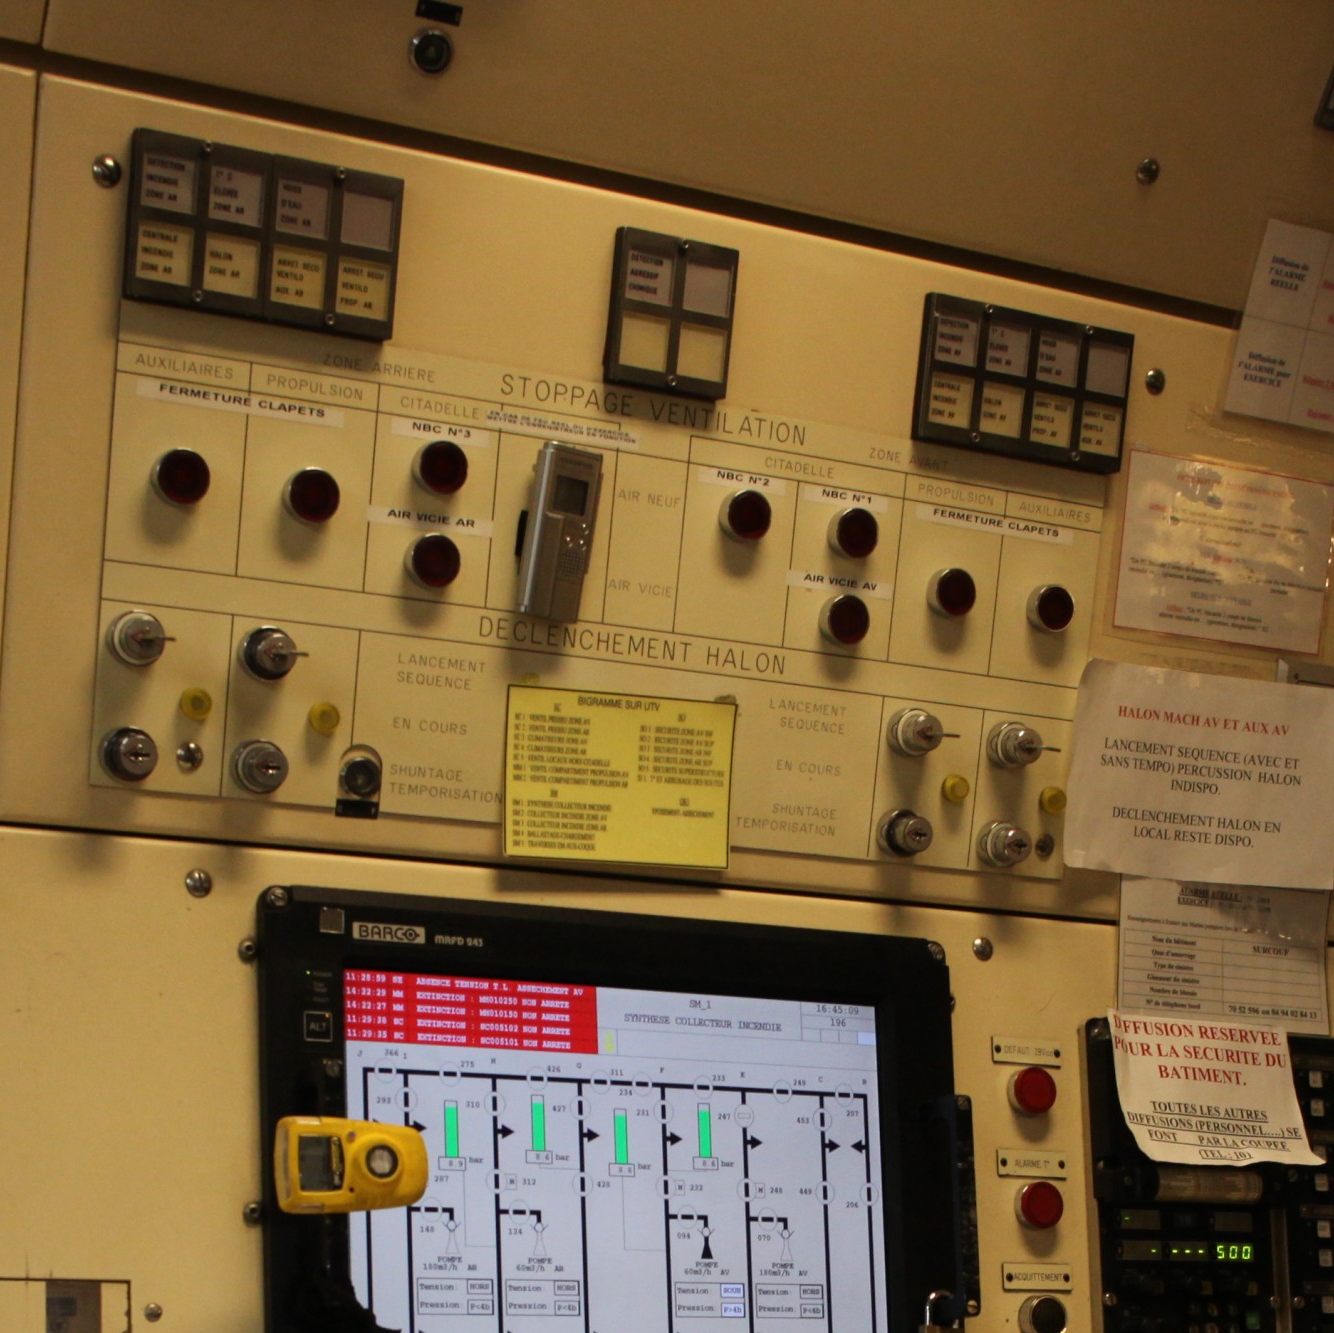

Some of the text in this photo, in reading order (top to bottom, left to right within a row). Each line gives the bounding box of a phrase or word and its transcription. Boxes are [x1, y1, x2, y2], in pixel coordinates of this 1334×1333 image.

[135, 352, 234, 380] AUXILIAIRES
[322, 353, 436, 384] ZONE ARRIERE
[266, 373, 364, 401] PROPULSION
[159, 383, 326, 418] FERMETURE CLAPETS
[399, 396, 480, 420] CITADELLE
[500, 373, 807, 447] STOPPAGE VENTILATION
[411, 421, 471, 440] NBC N°3
[764, 456, 835, 480] CITADELLE
[868, 447, 949, 471] ZONE AVANT
[716, 470, 770, 487] NBC N°2
[617, 488, 681, 509] AIR NEUF
[821, 488, 873, 504] NBC N°1
[917, 482, 995, 507] PROPULSION
[387, 508, 476, 529] AIR VICIE AR
[933, 507, 1060, 538] FERMETURE CLAPETS
[1018, 501, 1091, 524] AUXILIAIRES
[608, 577, 673, 599] AIR VICIE
[803, 572, 878, 592] AIR VICIE AV
[478, 615, 787, 676] DECLENCHEMENT HALON
[397, 651, 486, 674] LANCEMENT
[396, 670, 473, 692] SEQUENCE
[577, 695, 661, 712] BIGRAMME SUR UTV
[769, 698, 847, 718] LANCEMENT
[392, 717, 468, 736] EN COURS
[779, 716, 846, 735] SEQUENCE
[1117, 705, 1291, 737] HALON MACH AV ET AUX AV
[1104, 736, 1301, 771] LANCEMENT SEQUENCE (AVEC ET
[389, 763, 464, 783] SHUNTAGE
[775, 760, 842, 777] EN COURS
[1100, 754, 1302, 787] SANS TEMPO) PERCUSSION HALON
[389, 783, 503, 804] TEMPORISATION
[1170, 778, 1221, 798] INDISPO.
[771, 802, 838, 821] SHUNTAGE
[1111, 806, 1282, 834] DECLENCHEMENT HALON EN
[735, 816, 836, 838] TEMPORISATION
[1133, 825, 1255, 850] LOCAL RESTE DISPO.
[357, 923, 421, 943] BARCO
[1252, 945, 1290, 957] SURCOUF
[416, 991, 466, 1003] EXTINCTION
[416, 1005, 466, 1017] EXTINCTION
[816, 1003, 860, 1016] 16:45:09
[308, 1021, 328, 1033] ALT
[417, 1018, 466, 1030] EXTINCTION
[624, 1012, 783, 1033] SYNTHESE COLLECTEUR INCENDIE
[829, 1017, 847, 1028] 196
[1113, 1014, 1282, 1048] DFFUSION RESERVEE
[417, 1032, 467, 1044] EXTINCTION
[1114, 1035, 1287, 1069] POUR LA SECURITE DU
[1158, 1064, 1248, 1087] BATIMENT.
[1150, 1100, 1268, 1121] TOUTES LES AUTRES
[1126, 1111, 1302, 1138] DIFFUSIONS SE
[1147, 1129, 1179, 1143] FONT
[1197, 1134, 1223, 1148] PAR
[1223, 1138, 1240, 1149] LA
[1014, 1158, 1042, 1169] ALARME
[1216, 1245, 1252, 1260] 500
[1013, 1271, 1064, 1284] ACQUITTEMENT
